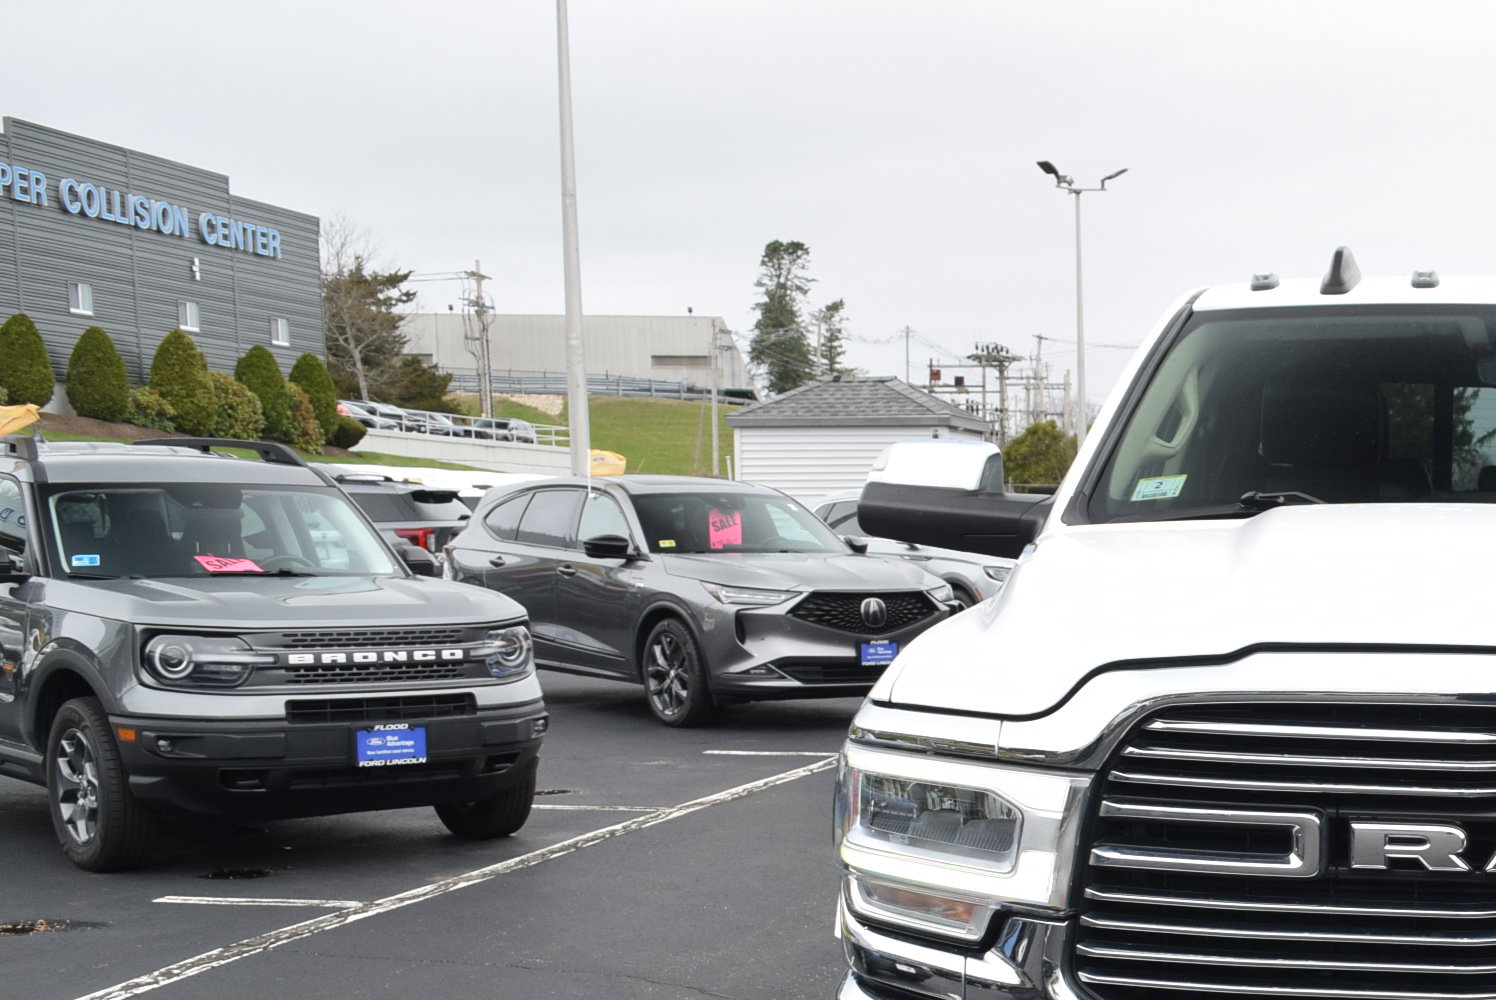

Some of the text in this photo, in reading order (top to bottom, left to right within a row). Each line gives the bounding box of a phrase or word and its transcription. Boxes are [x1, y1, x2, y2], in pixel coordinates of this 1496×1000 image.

[0, 162, 282, 258] PER COLLISION CENTER
[288, 649, 463, 664] BRONCO
[373, 723, 409, 732] FLOOD
[386, 757, 427, 766] LINCOLN
